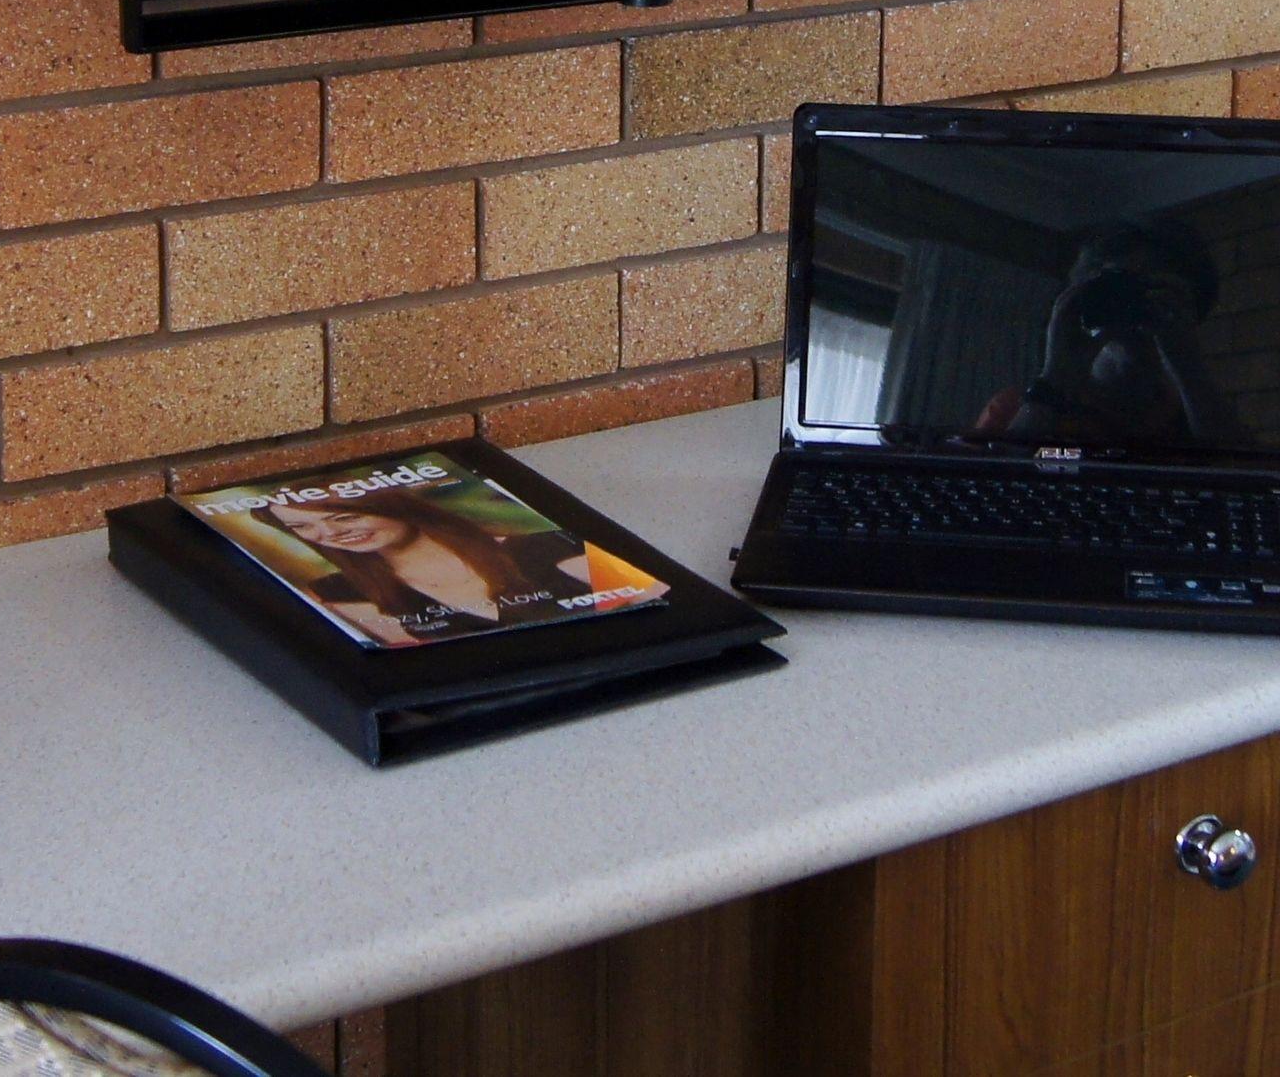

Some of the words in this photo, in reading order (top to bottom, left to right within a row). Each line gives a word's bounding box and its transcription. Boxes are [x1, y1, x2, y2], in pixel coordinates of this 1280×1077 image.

[195, 486, 330, 516] movie
[329, 464, 449, 500] guide
[557, 586, 647, 611] FOXTEL
